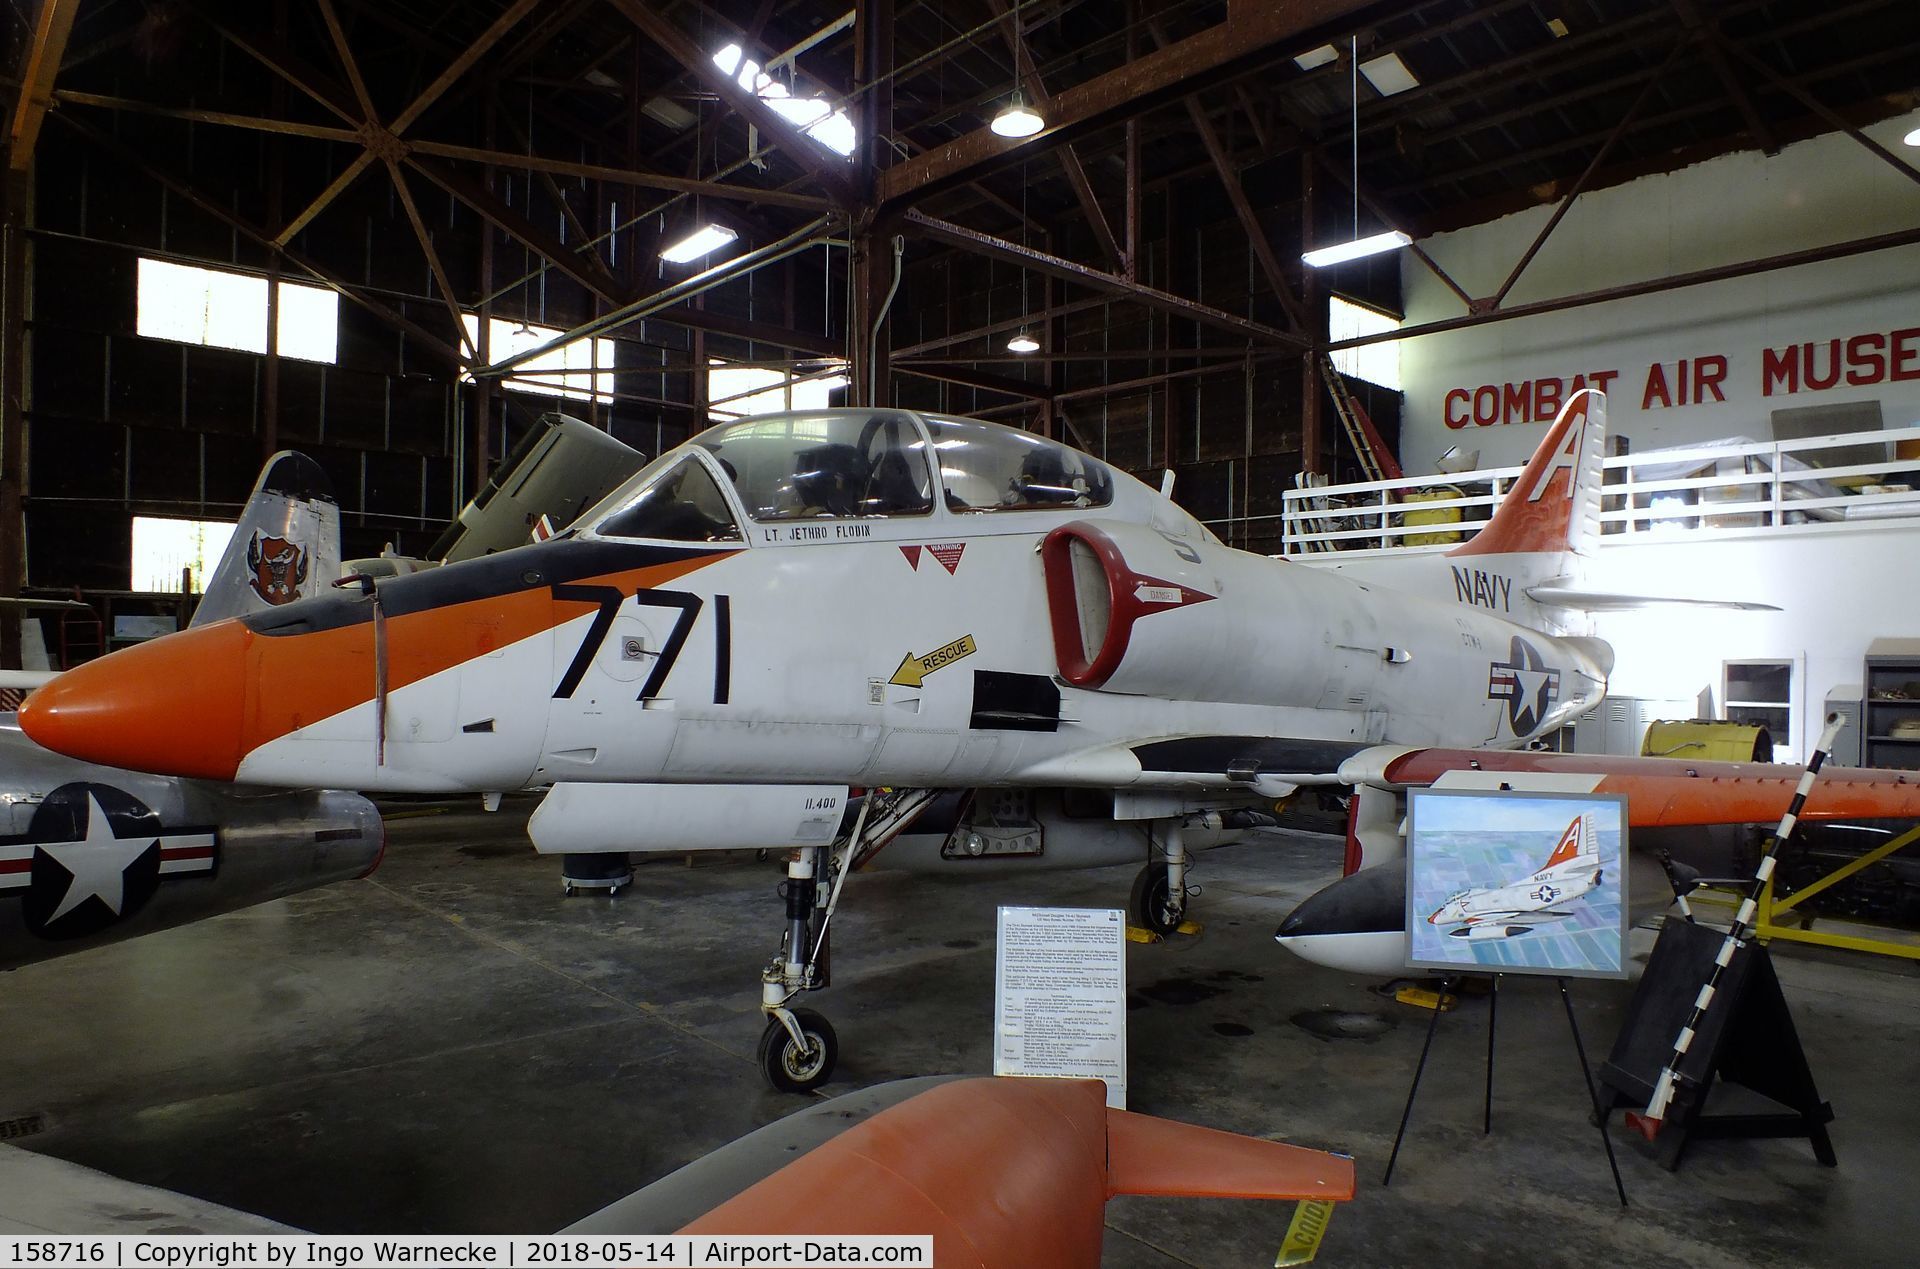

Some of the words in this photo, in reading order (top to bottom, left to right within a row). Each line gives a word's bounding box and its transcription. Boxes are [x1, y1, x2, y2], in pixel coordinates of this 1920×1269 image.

[1642, 354, 1728, 410] AIR
[1763, 328, 1920, 396] MUSE
[1528, 412, 1586, 503] A
[765, 529, 783, 541] LT.
[789, 527, 828, 540] JETHRO
[931, 543, 962, 552] WARNING
[1451, 565, 1511, 613] NAVY
[550, 584, 731, 705] 771
[922, 640, 969, 671] RESCUE
[805, 797, 836, 810] 11.400
[1558, 822, 1580, 855] A
[1534, 871, 1554, 883] NAVY
